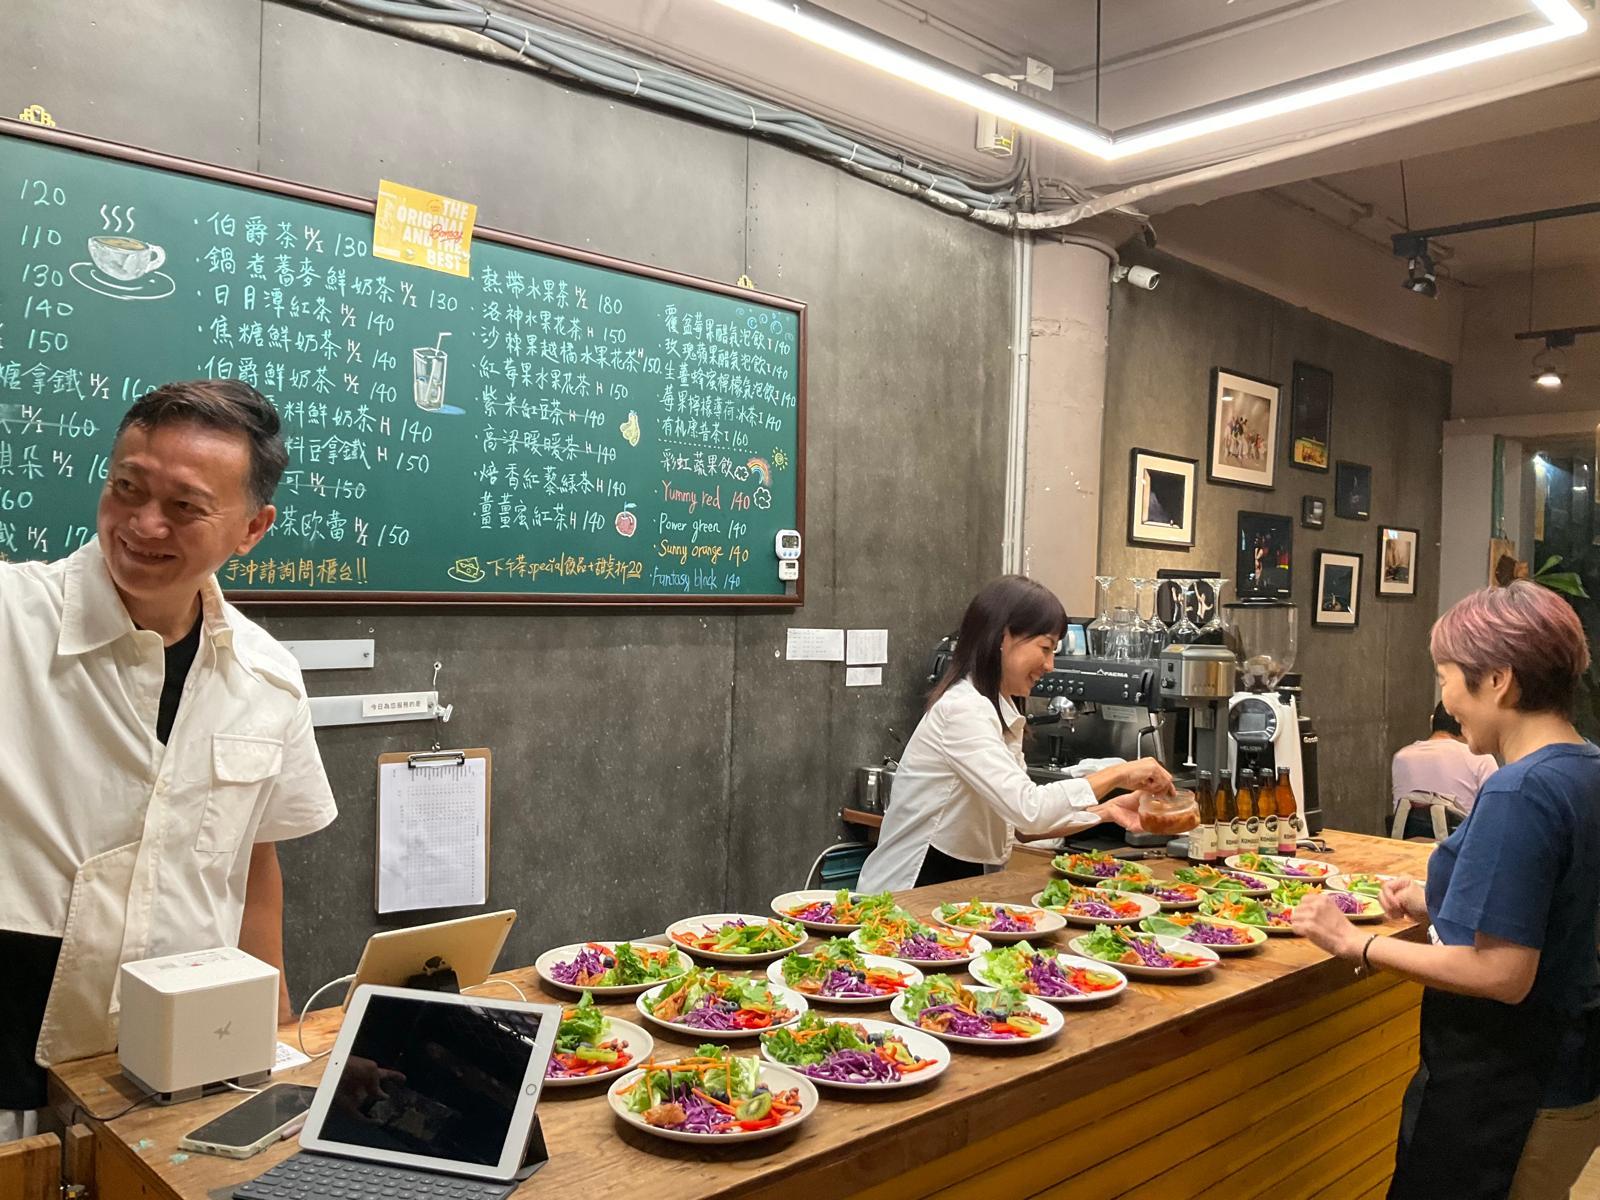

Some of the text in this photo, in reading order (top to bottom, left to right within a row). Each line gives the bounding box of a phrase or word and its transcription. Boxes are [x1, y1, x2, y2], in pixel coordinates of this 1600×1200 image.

[20, 179, 66, 206] 120
[396, 205, 464, 234] ORIGINAL
[441, 200, 470, 221] THE
[20, 225, 62, 247] 110
[207, 211, 298, 249] 伯爵茶
[334, 233, 367, 258] 130
[402, 226, 433, 249] AND
[426, 249, 462, 272] BEST
[22, 265, 63, 288] 130
[204, 246, 395, 303] 鍋煮蕎麥鮮奶茶
[429, 290, 458, 311] 130
[482, 265, 569, 308] 熱帶水果茶
[598, 294, 622, 315] 180
[25, 297, 73, 318] 140
[214, 285, 332, 324] 日月潭紅茶
[367, 311, 394, 336] 140
[482, 301, 626, 344] 洛神水果花茶 H 150
[28, 329, 68, 353] 150
[210, 315, 342, 361] 焦糖鮮奶茶
[372, 349, 397, 371] 140
[774, 340, 791, 355] 140
[637, 348, 644, 358] H
[642, 357, 660, 374] 150
[479, 355, 628, 400] 紅莓果水果花茶 H 150
[772, 366, 788, 380] 140
[370, 381, 397, 403] 140
[781, 391, 797, 408] 140
[59, 412, 96, 438] 160
[380, 416, 390, 435] H
[401, 419, 432, 444] 140
[569, 409, 576, 422] H
[584, 409, 605, 428] 140
[765, 413, 782, 432] 140
[732, 430, 749, 446] 160
[377, 447, 387, 461] H
[396, 452, 429, 473] 150
[585, 441, 592, 454] H
[597, 444, 616, 464] 140
[660, 448, 735, 480] 彩虹蔬果飲
[335, 478, 366, 499] 150
[596, 478, 603, 493] H
[607, 478, 626, 497] 140
[662, 480, 750, 514] Yummy red 140
[570, 511, 577, 530] H
[583, 510, 605, 533] 140
[660, 512, 747, 543] Power green 140
[377, 525, 409, 547] 150
[658, 539, 749, 567] Sunny orange 140
[724, 573, 741, 590] 140
